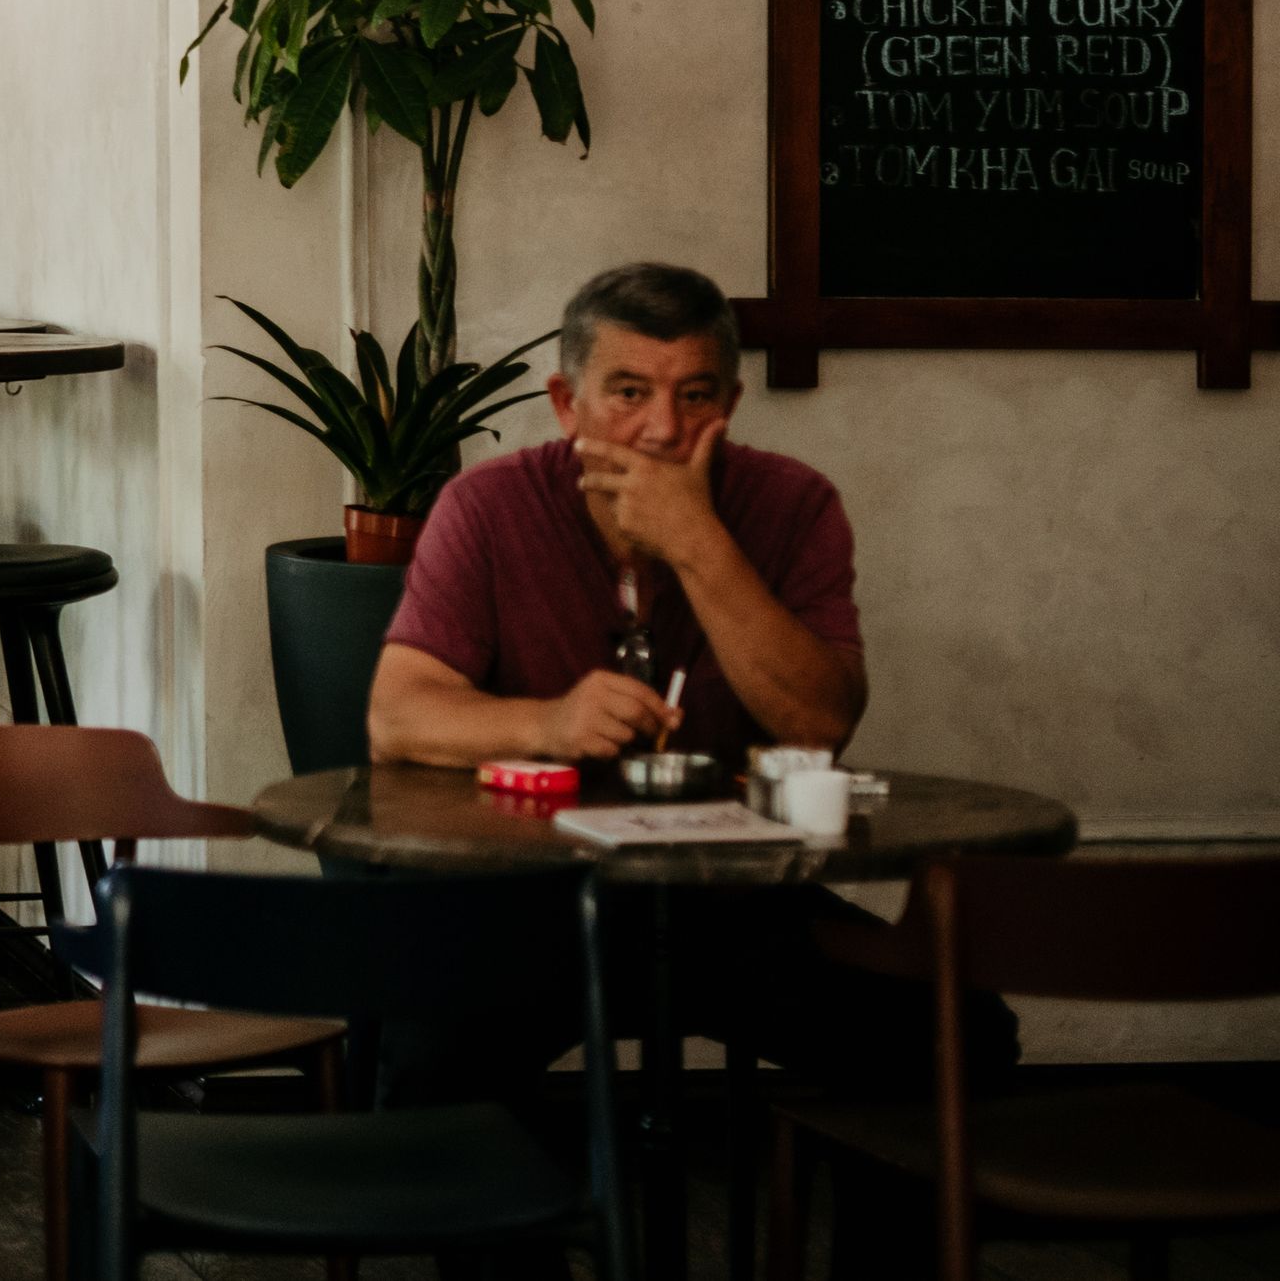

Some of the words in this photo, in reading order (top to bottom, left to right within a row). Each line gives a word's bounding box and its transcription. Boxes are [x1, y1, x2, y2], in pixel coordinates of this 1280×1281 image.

[1055, 31, 1172, 87] RED)
[855, 90, 953, 132] TOM
[975, 88, 1065, 132] YUM
[1076, 86, 1190, 134] SOUP
[843, 144, 939, 190] TOM
[947, 146, 1039, 191] KHA
[1049, 146, 1121, 193] GAI
